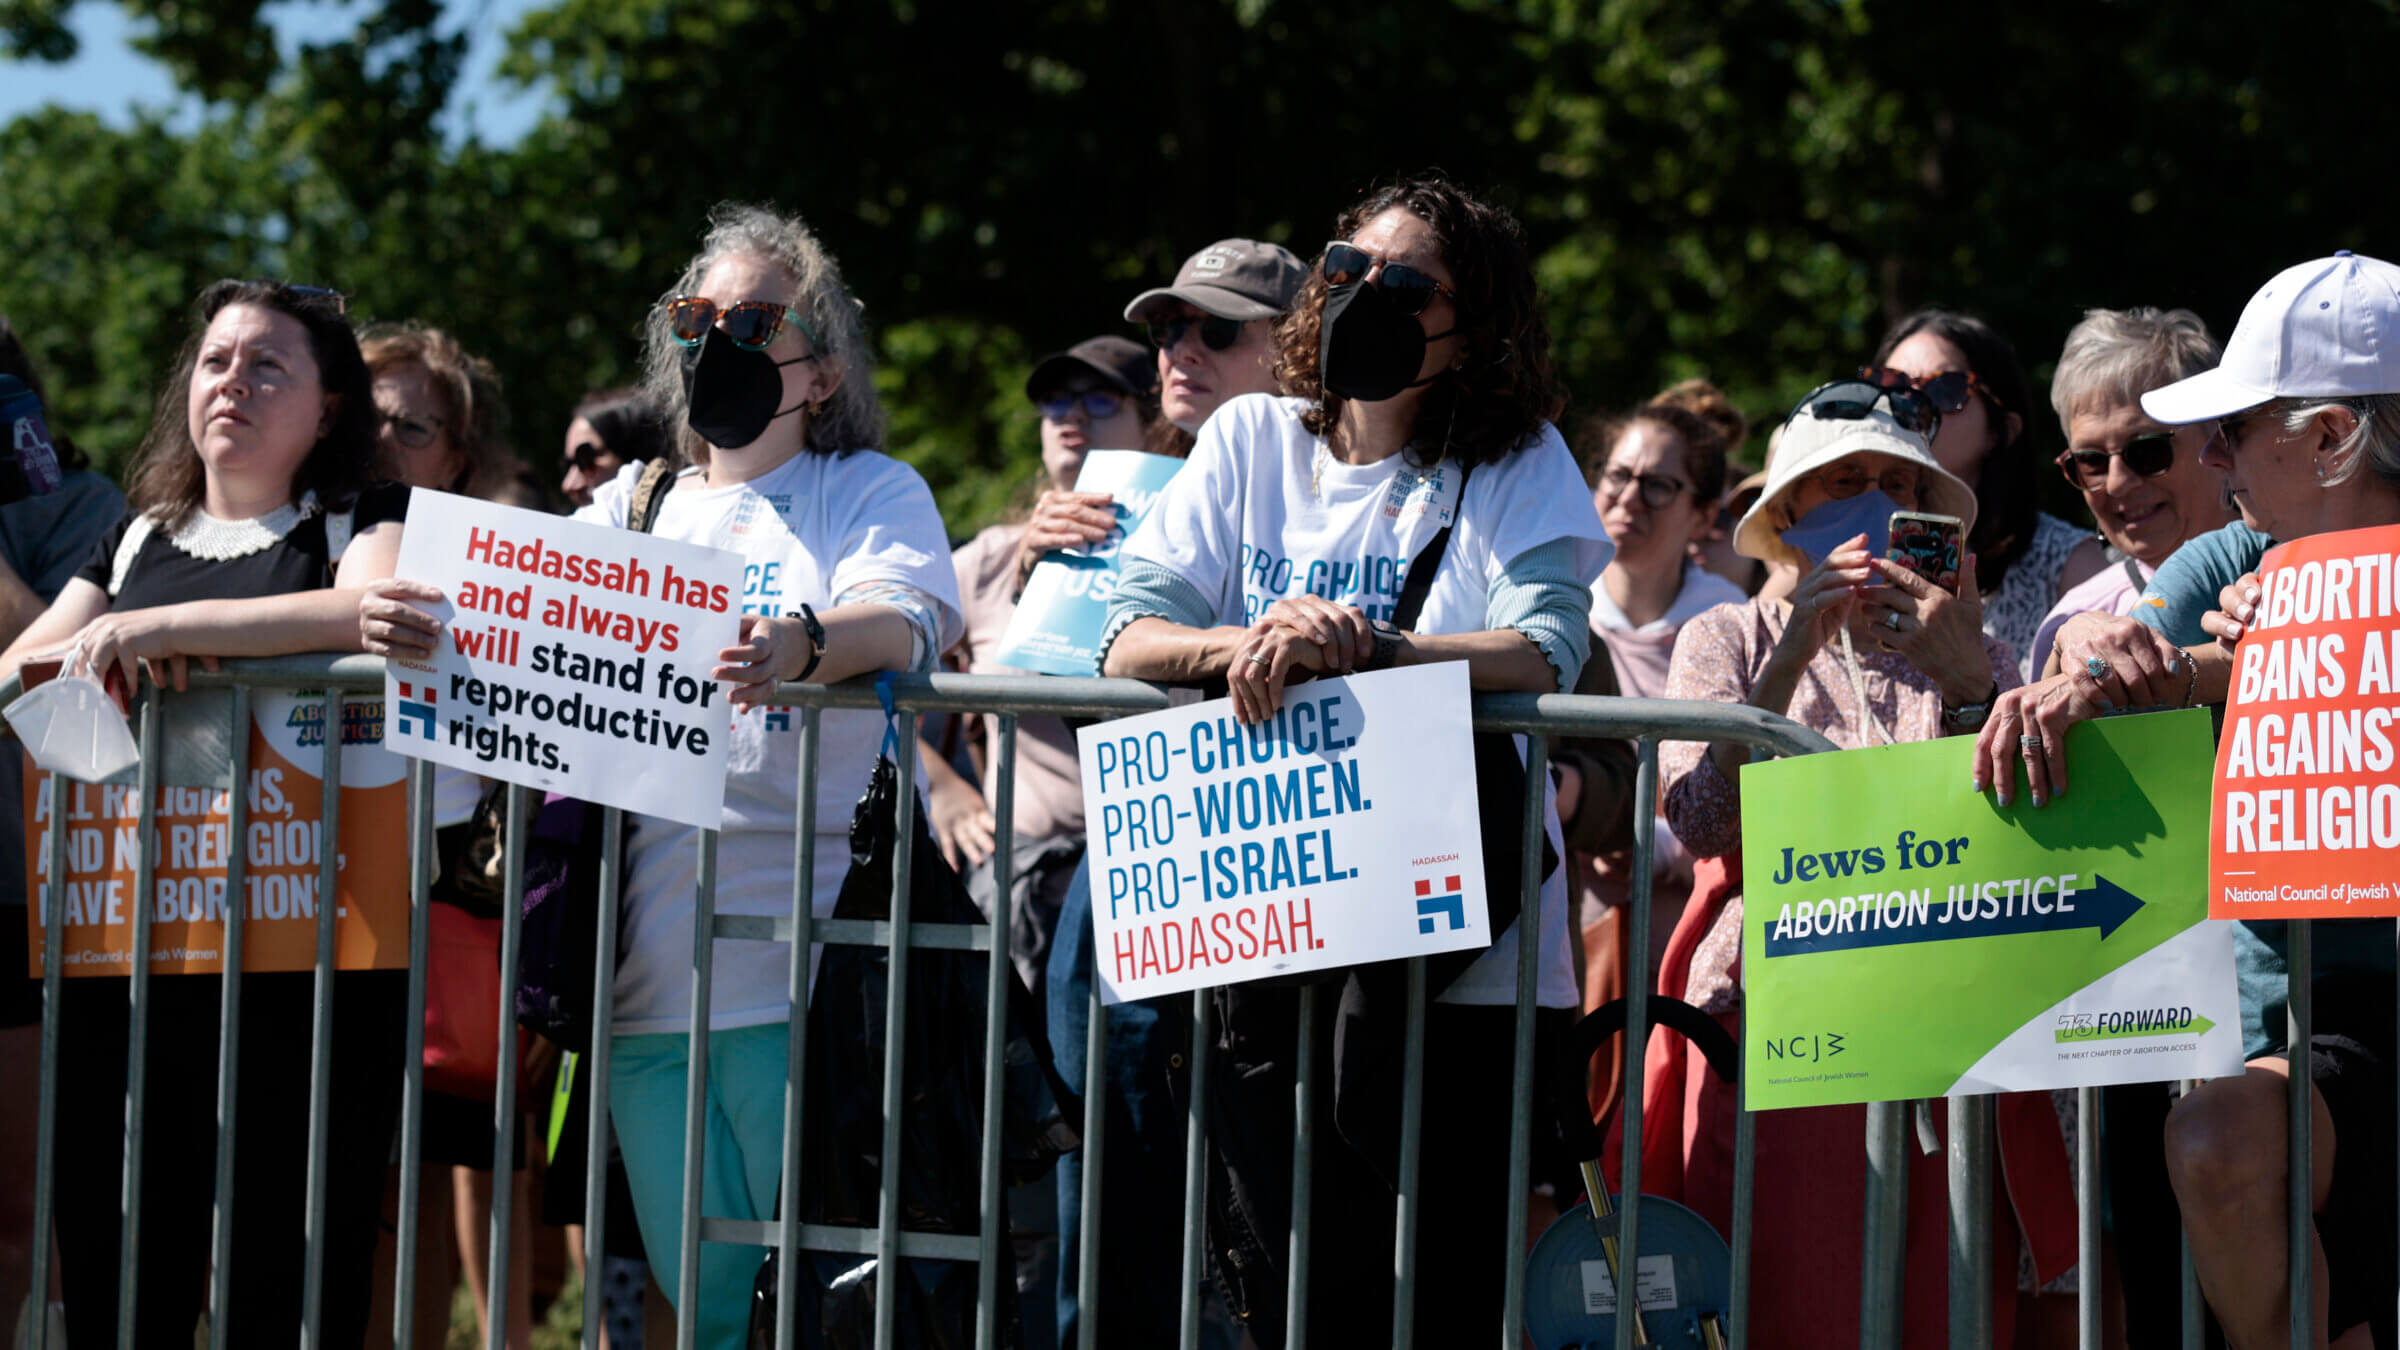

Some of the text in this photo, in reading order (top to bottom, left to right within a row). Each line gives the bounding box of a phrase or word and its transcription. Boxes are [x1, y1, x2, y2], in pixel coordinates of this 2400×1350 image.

[466, 526, 650, 597] Hadassah
[661, 565, 729, 613] has
[2248, 553, 2400, 632] ABORTI
[457, 580, 680, 653] and always
[453, 625, 718, 708] will stand for
[2237, 633, 2345, 705] BANS
[302, 723, 384, 742] JUTICE
[449, 716, 570, 773] rights.
[450, 672, 709, 756] reproductive
[1097, 696, 1356, 793] PRO-CHOICE.
[1102, 758, 1372, 856] PRO-WOMEN.
[1108, 829, 1359, 920] PRO-ISRAEL.
[1412, 853, 1460, 867] HADASSAH
[1773, 830, 1969, 885] Jews for
[2224, 885, 2277, 902] National
[2280, 884, 2328, 901] Council
[2330, 883, 2345, 900] of
[2345, 882, 2390, 904] Jewish
[1113, 898, 1325, 983] HADASSAH.
[1772, 874, 2077, 942] ABORTION JUSTICE
[172, 946, 218, 961] Women
[2057, 1043, 2197, 1061] THE NEXT CHAPTER OF ABORTION ACCESS
[2058, 1006, 2192, 1039] 73 FORWARD
